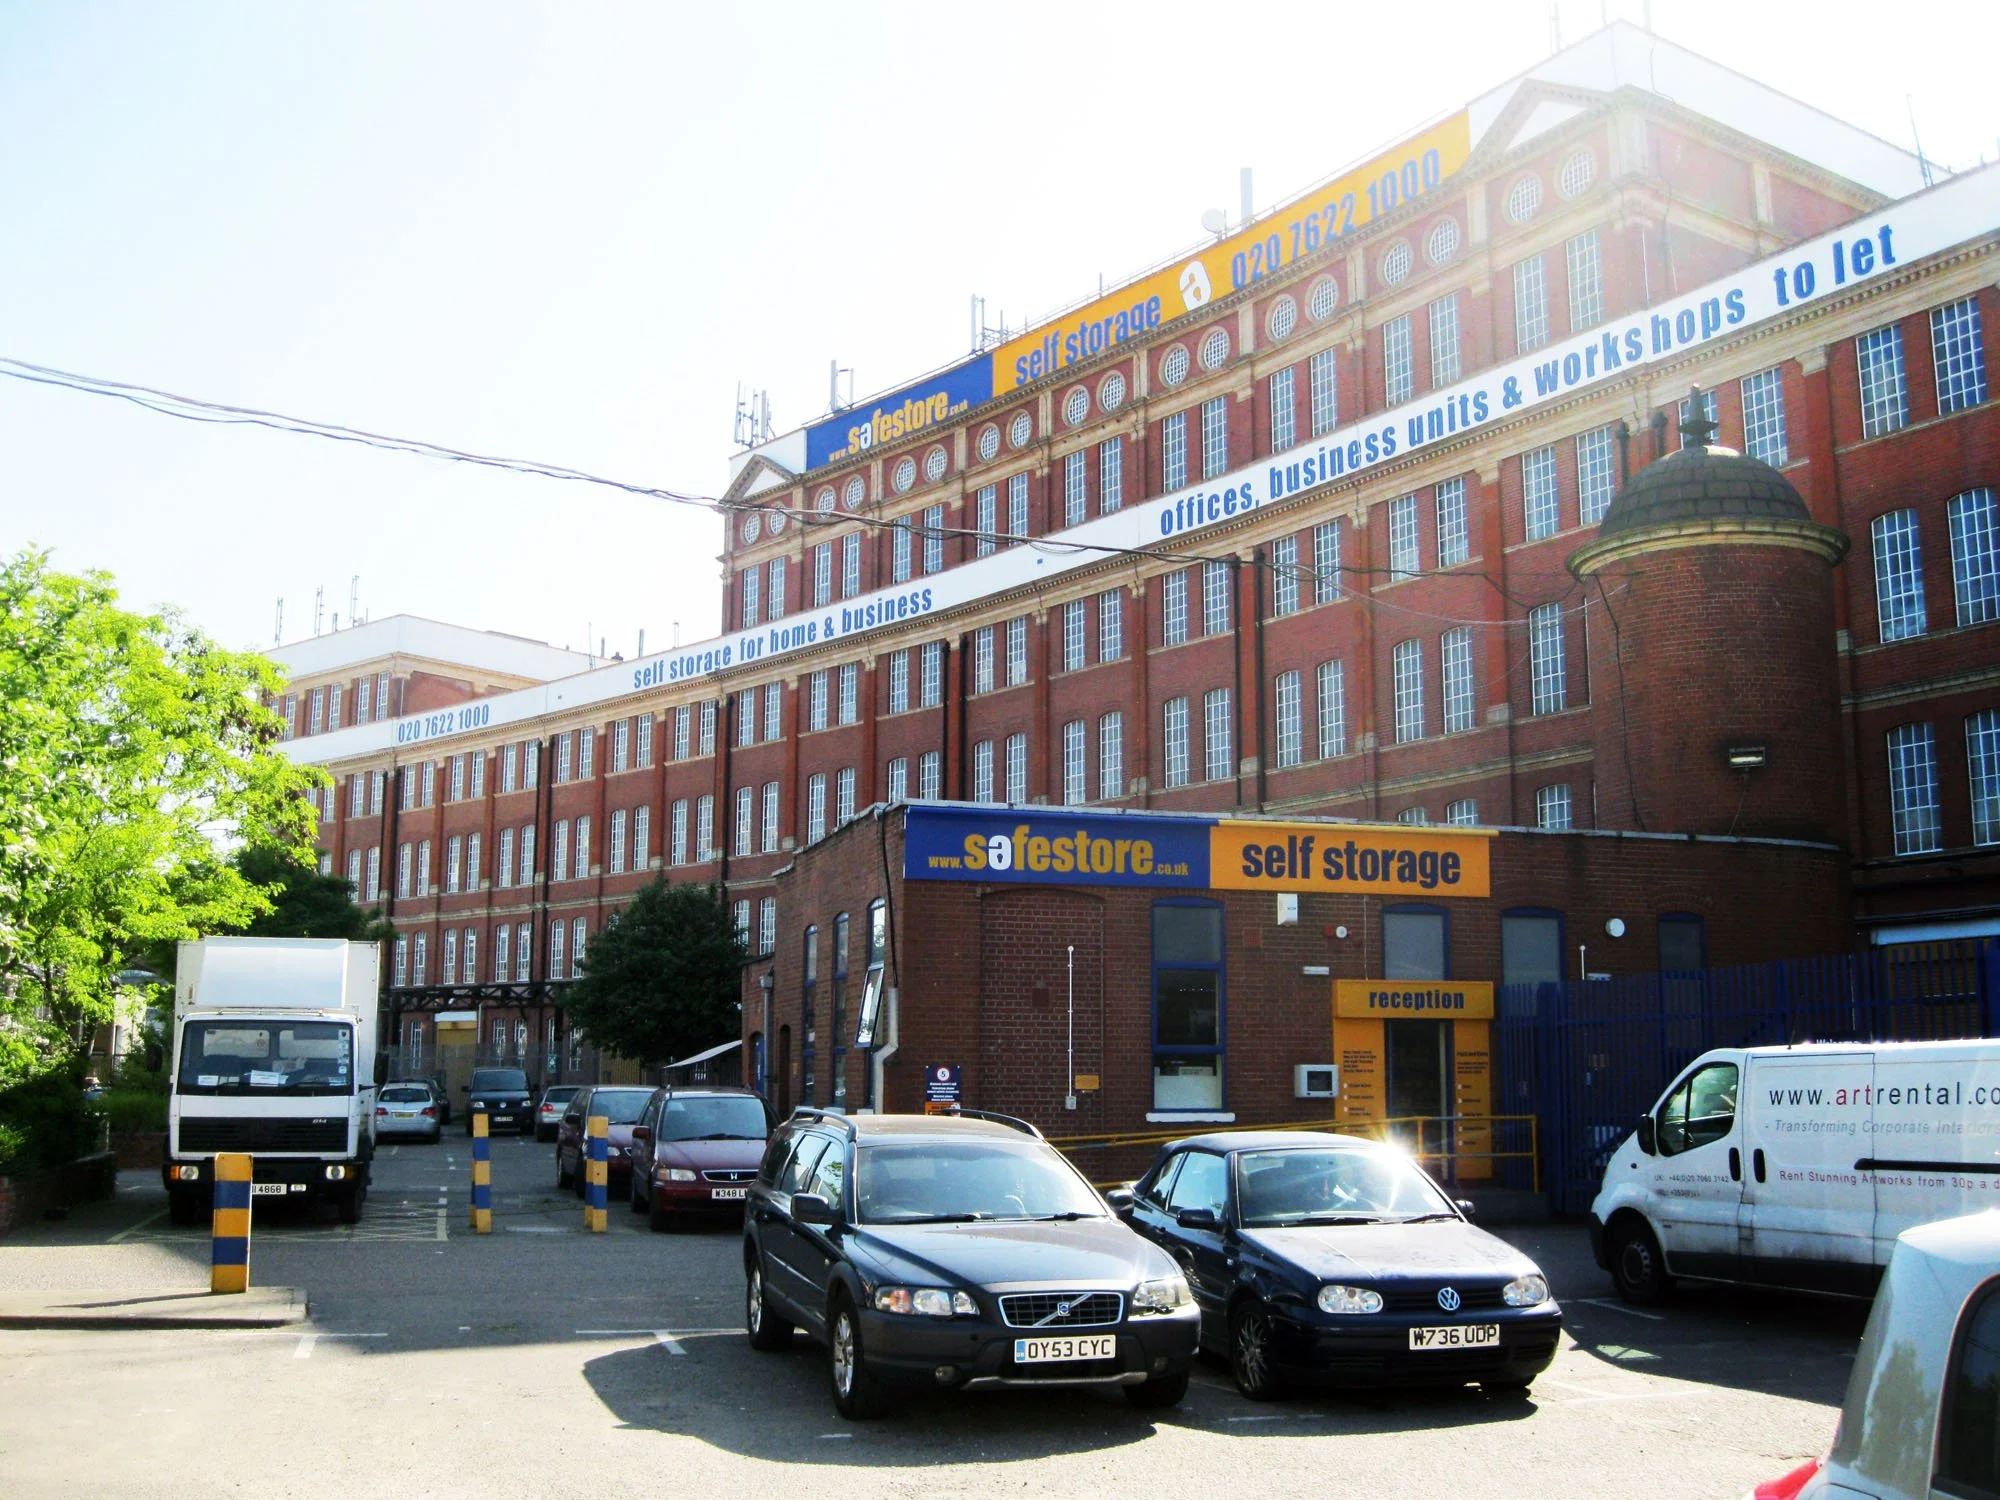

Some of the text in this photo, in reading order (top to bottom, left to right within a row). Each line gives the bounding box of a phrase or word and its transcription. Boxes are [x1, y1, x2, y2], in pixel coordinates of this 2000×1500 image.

[1231, 147, 1441, 290] 020 7622 1000
[1015, 292, 1161, 387] self storage
[1160, 222, 1897, 537] offices, business units & workshops to let
[633, 587, 933, 690] self storage for home & business
[397, 702, 490, 744] 020 7622 1000
[1241, 834, 1461, 890] self storage
[1368, 987, 1465, 1012] reception
[1775, 1119, 1857, 1136] Transforming
[1861, 1119, 1930, 1135] Corporate
[1779, 1170, 1804, 1182] Rent
[1808, 1171, 1857, 1185] Stunning
[1861, 1173, 1913, 1186] Artworks
[1917, 1176, 1945, 1188] from
[1028, 1338, 1111, 1359] OY53 CYC
[1464, 1326, 1497, 1344] UDP
